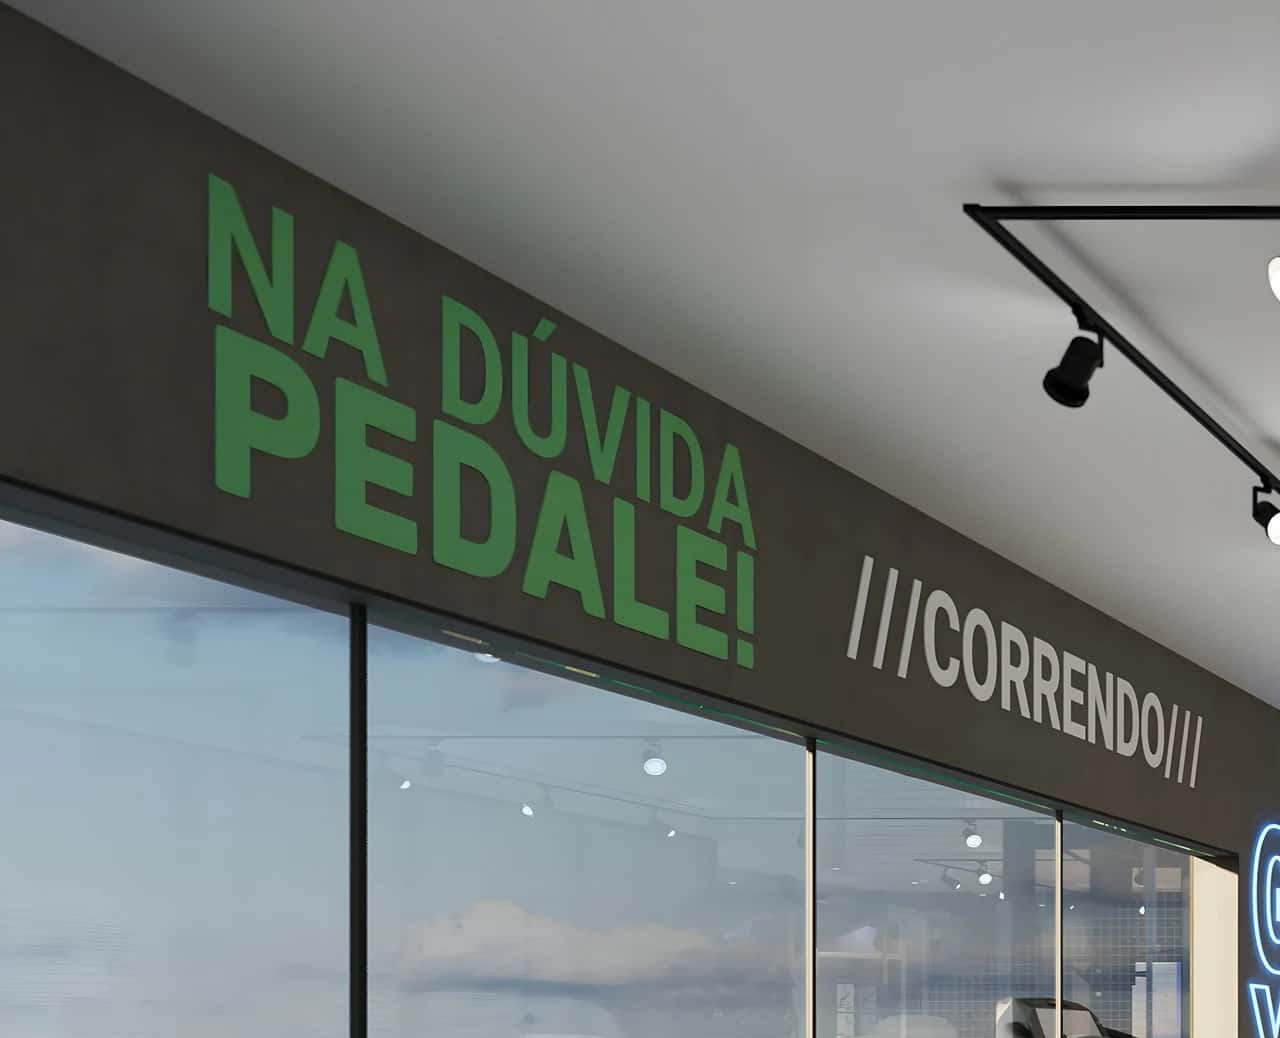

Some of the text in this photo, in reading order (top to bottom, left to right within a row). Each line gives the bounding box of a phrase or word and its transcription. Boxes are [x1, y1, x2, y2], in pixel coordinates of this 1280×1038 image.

[207, 172, 758, 549] NA DÚVIDA
[213, 324, 754, 670] PEDALE!
